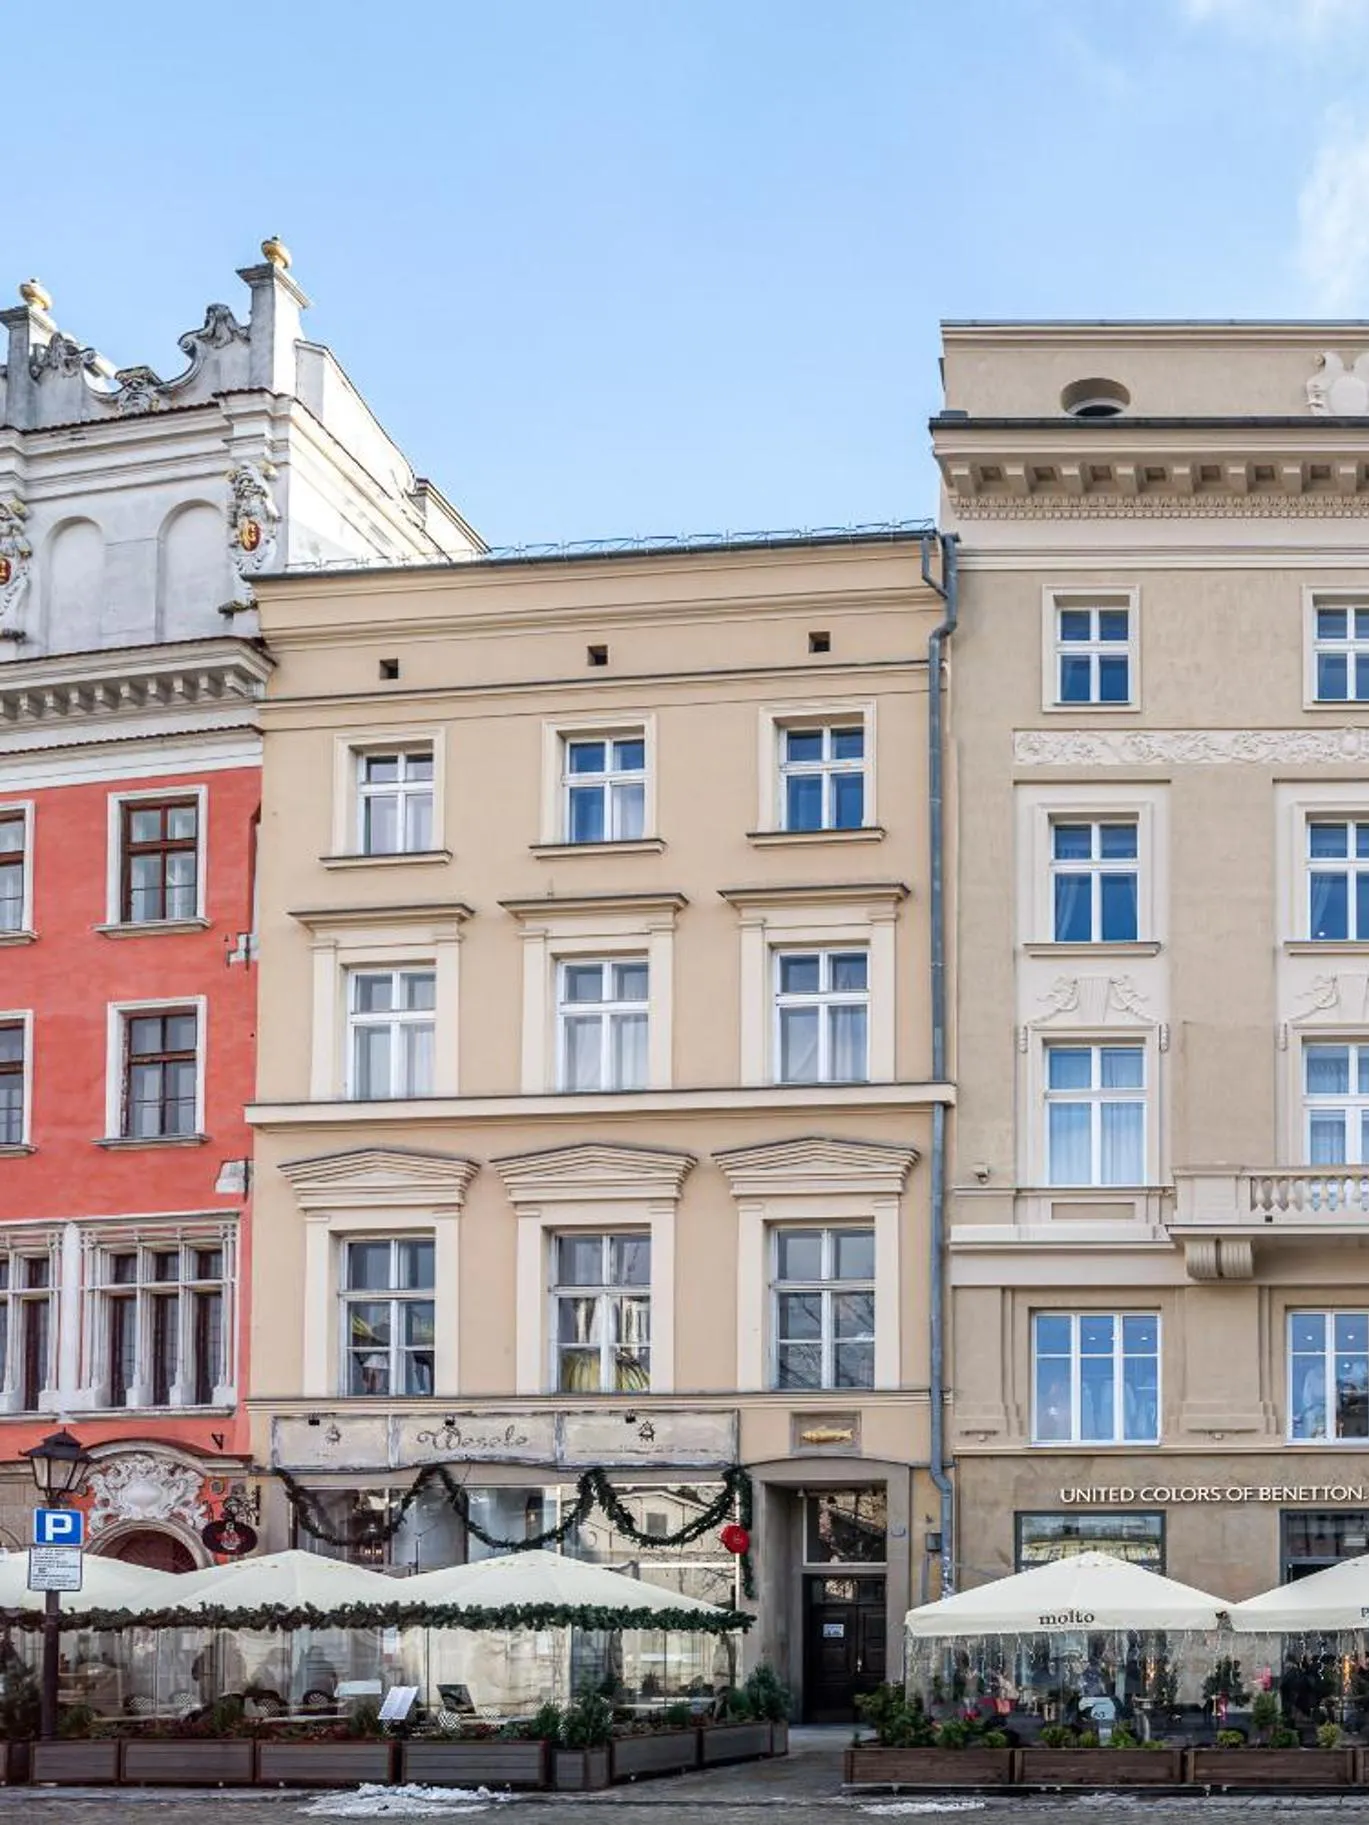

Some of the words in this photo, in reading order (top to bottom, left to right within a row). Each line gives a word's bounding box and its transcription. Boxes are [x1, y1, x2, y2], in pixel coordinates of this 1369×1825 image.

[1060, 1487, 1135, 1503] UNITED
[1140, 1486, 1222, 1502] COLORS
[1226, 1486, 1254, 1501] OF
[45, 1512, 73, 1541] P
[1038, 1609, 1095, 1625] molto
